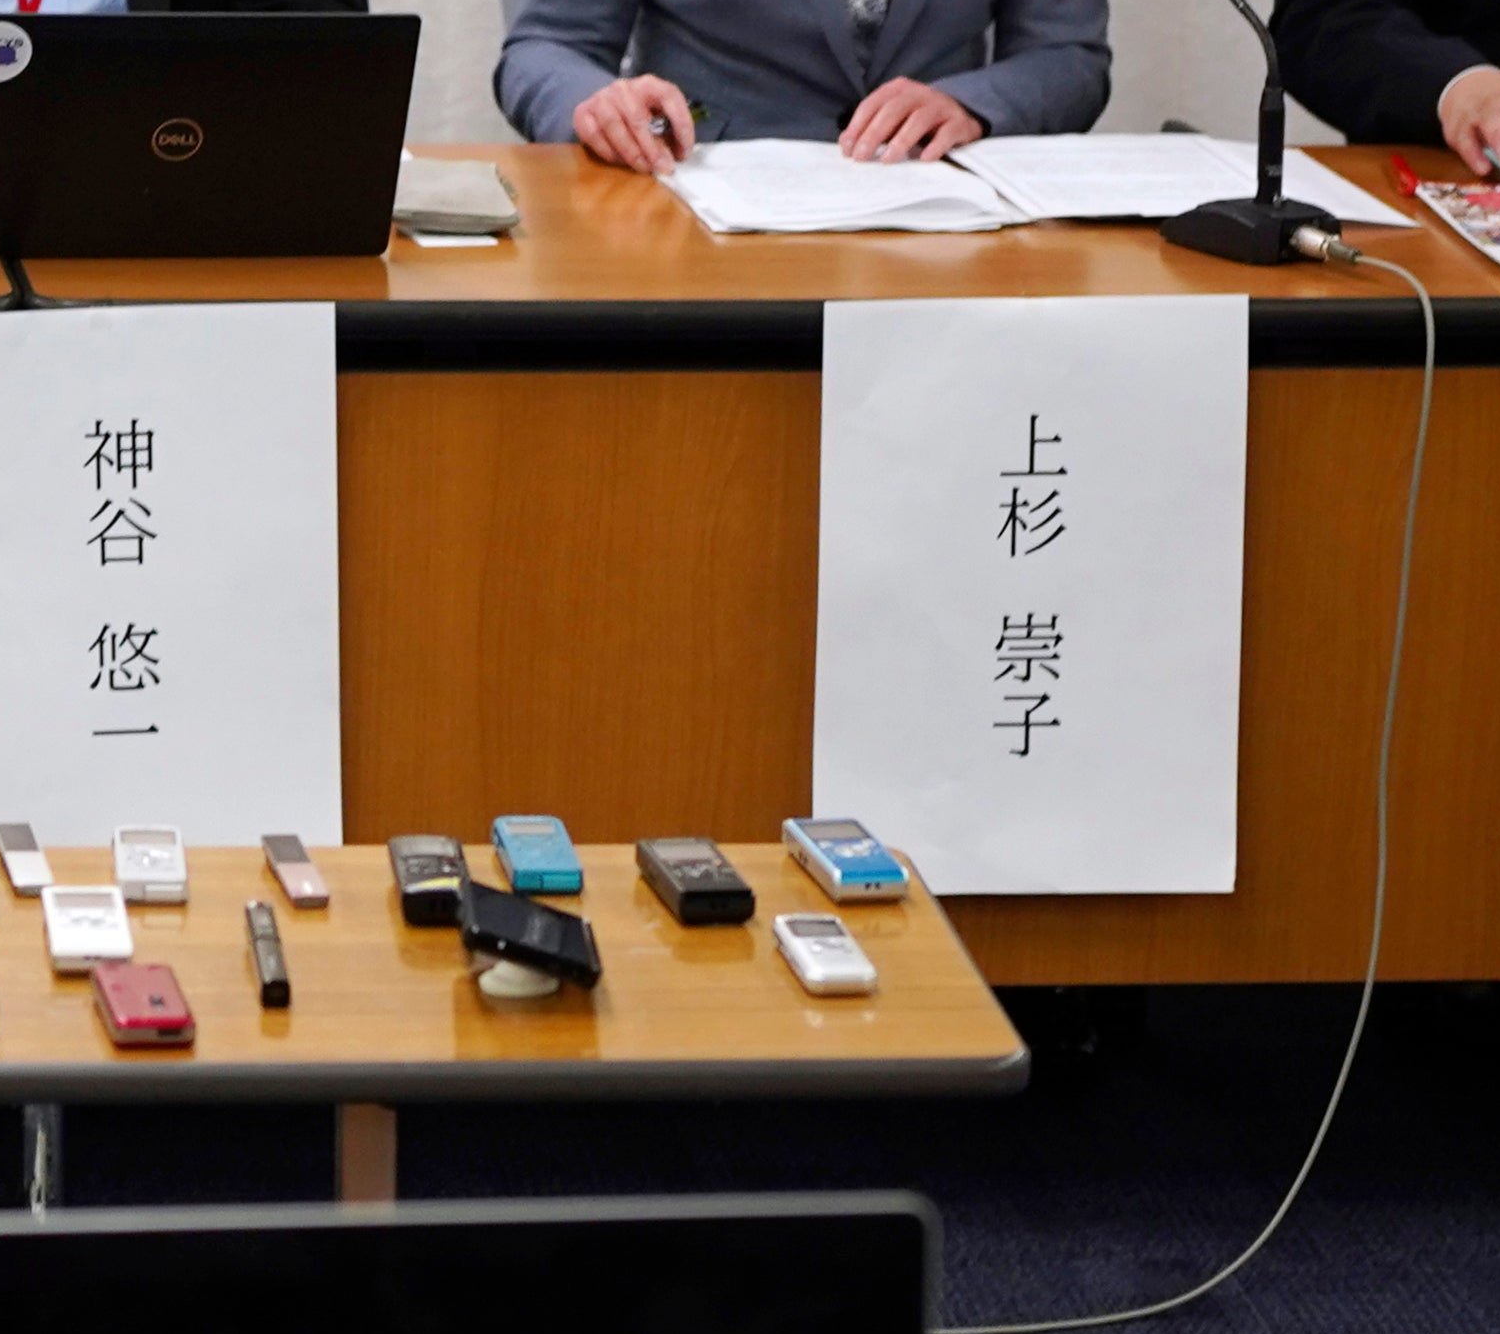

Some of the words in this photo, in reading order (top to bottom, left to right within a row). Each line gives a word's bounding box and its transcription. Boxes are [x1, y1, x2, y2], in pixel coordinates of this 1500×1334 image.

[83, 418, 157, 567] 神谷
[997, 414, 1068, 558] 上杉
[88, 622, 161, 738] 悠一
[993, 612, 1064, 758] 崇子
